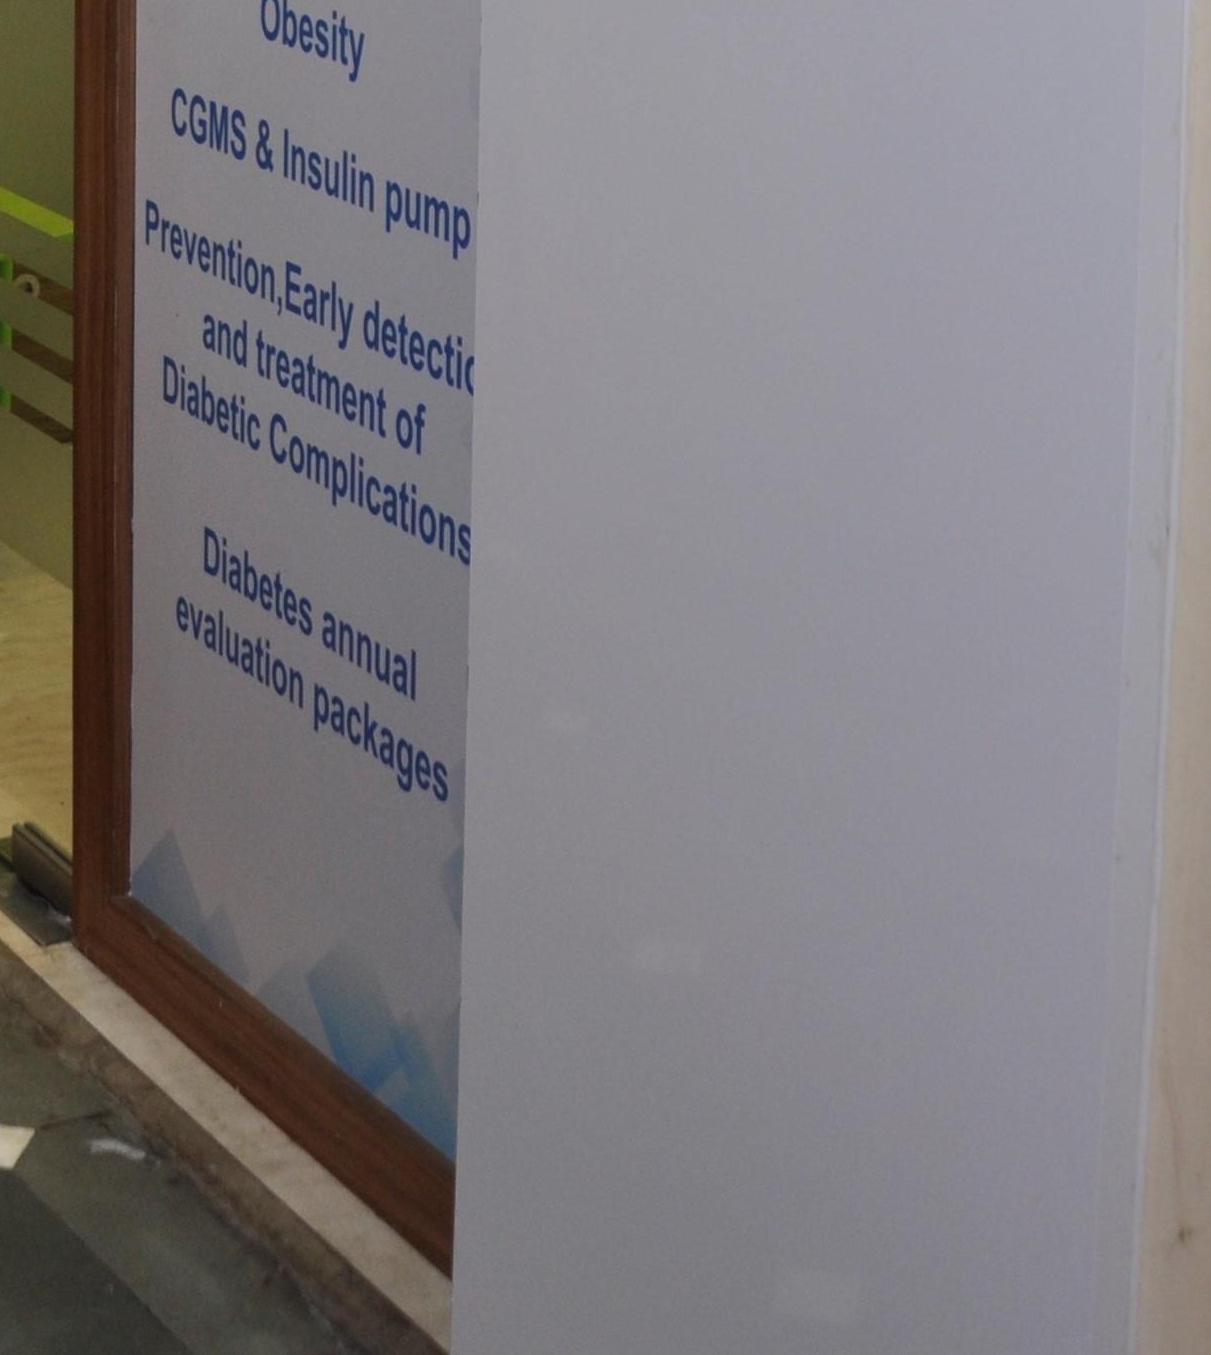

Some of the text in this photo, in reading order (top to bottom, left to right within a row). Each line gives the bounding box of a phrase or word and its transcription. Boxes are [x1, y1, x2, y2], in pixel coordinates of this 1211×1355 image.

[171, 88, 471, 260] CGMS & Insulin pump
[162, 355, 471, 566] Diabetic Complications
[203, 313, 426, 456] and treatment of
[176, 595, 449, 802] evaluation packages
[203, 526, 417, 701] Diabetes annual
